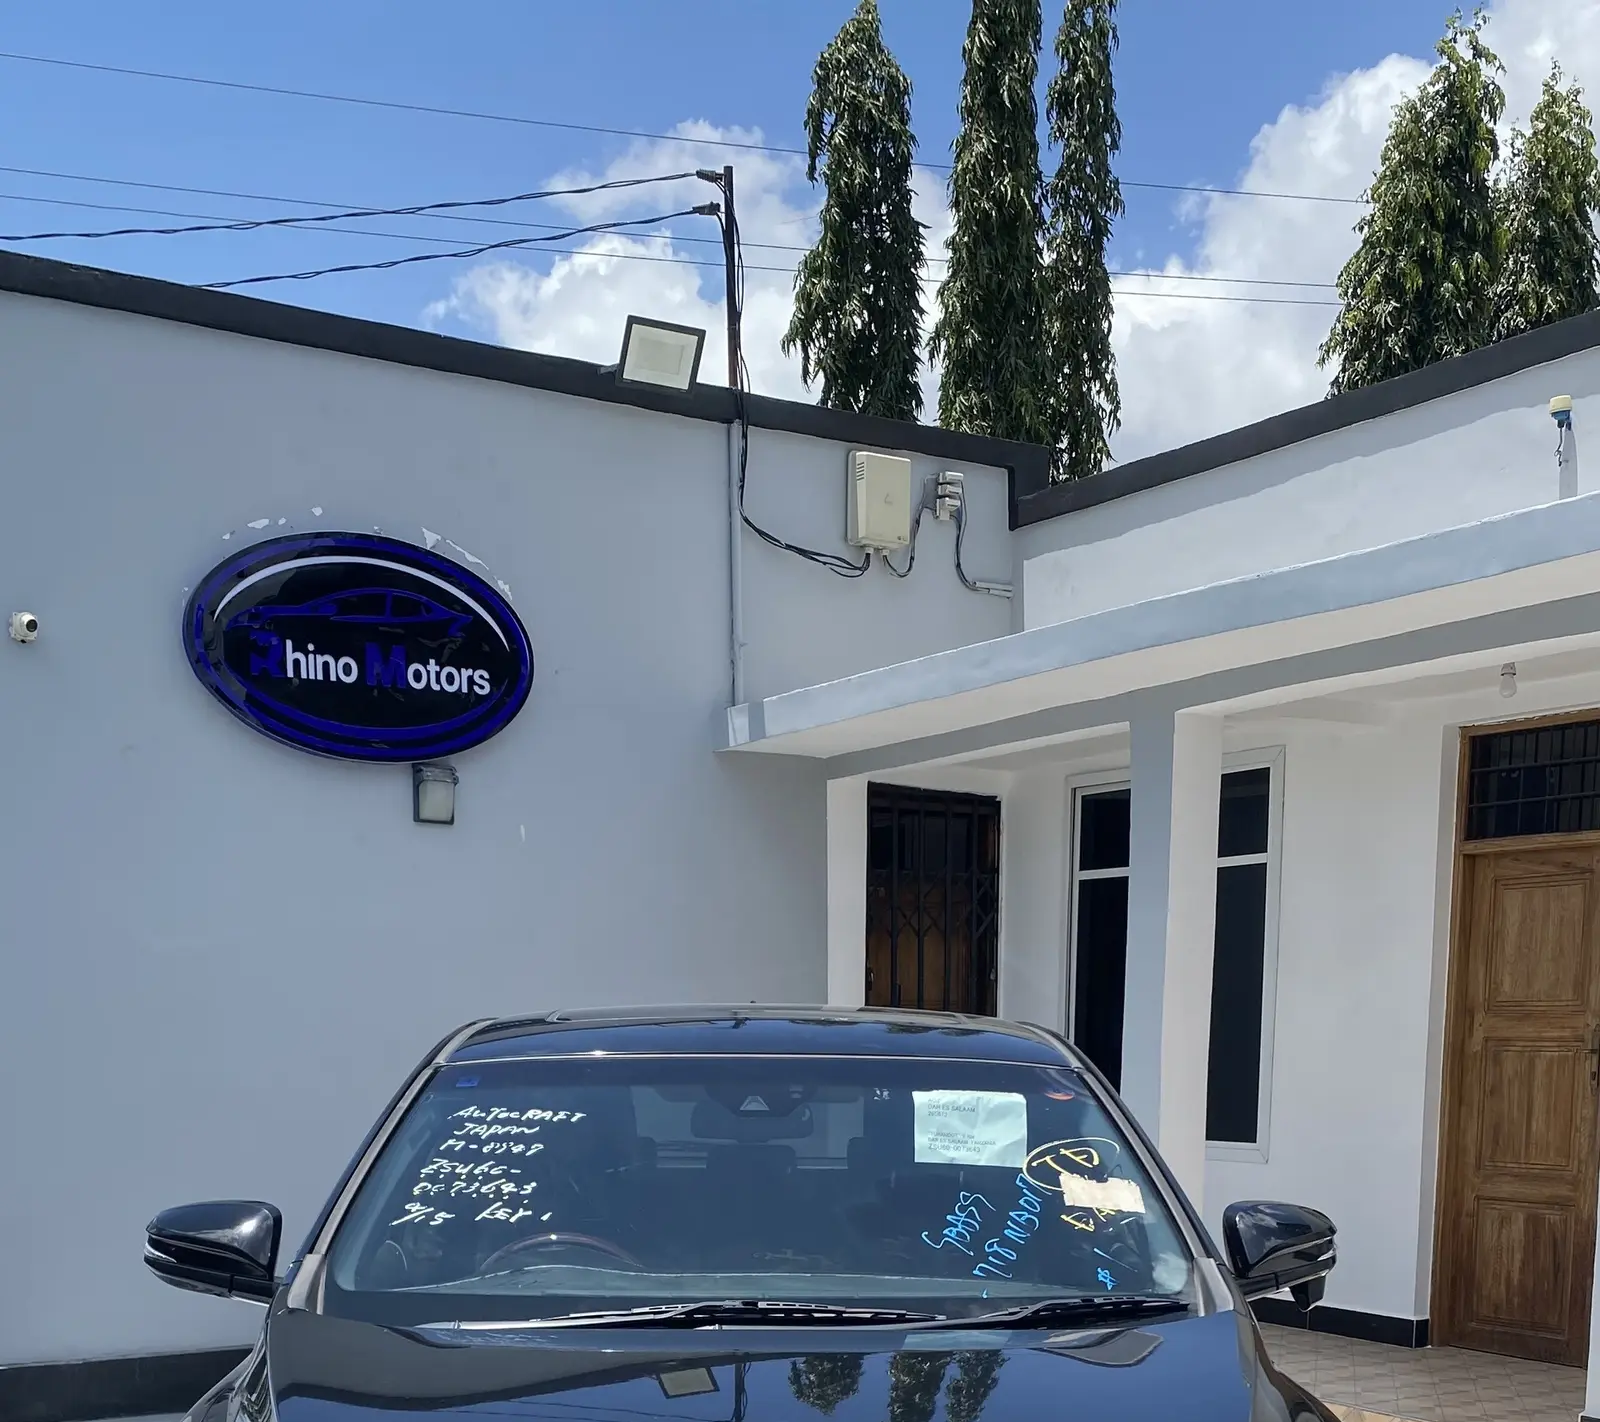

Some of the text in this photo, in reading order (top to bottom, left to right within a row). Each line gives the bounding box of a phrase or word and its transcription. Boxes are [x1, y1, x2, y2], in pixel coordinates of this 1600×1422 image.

[251, 630, 491, 695] Rhino Motors
[453, 1122, 540, 1139] JAPAN
